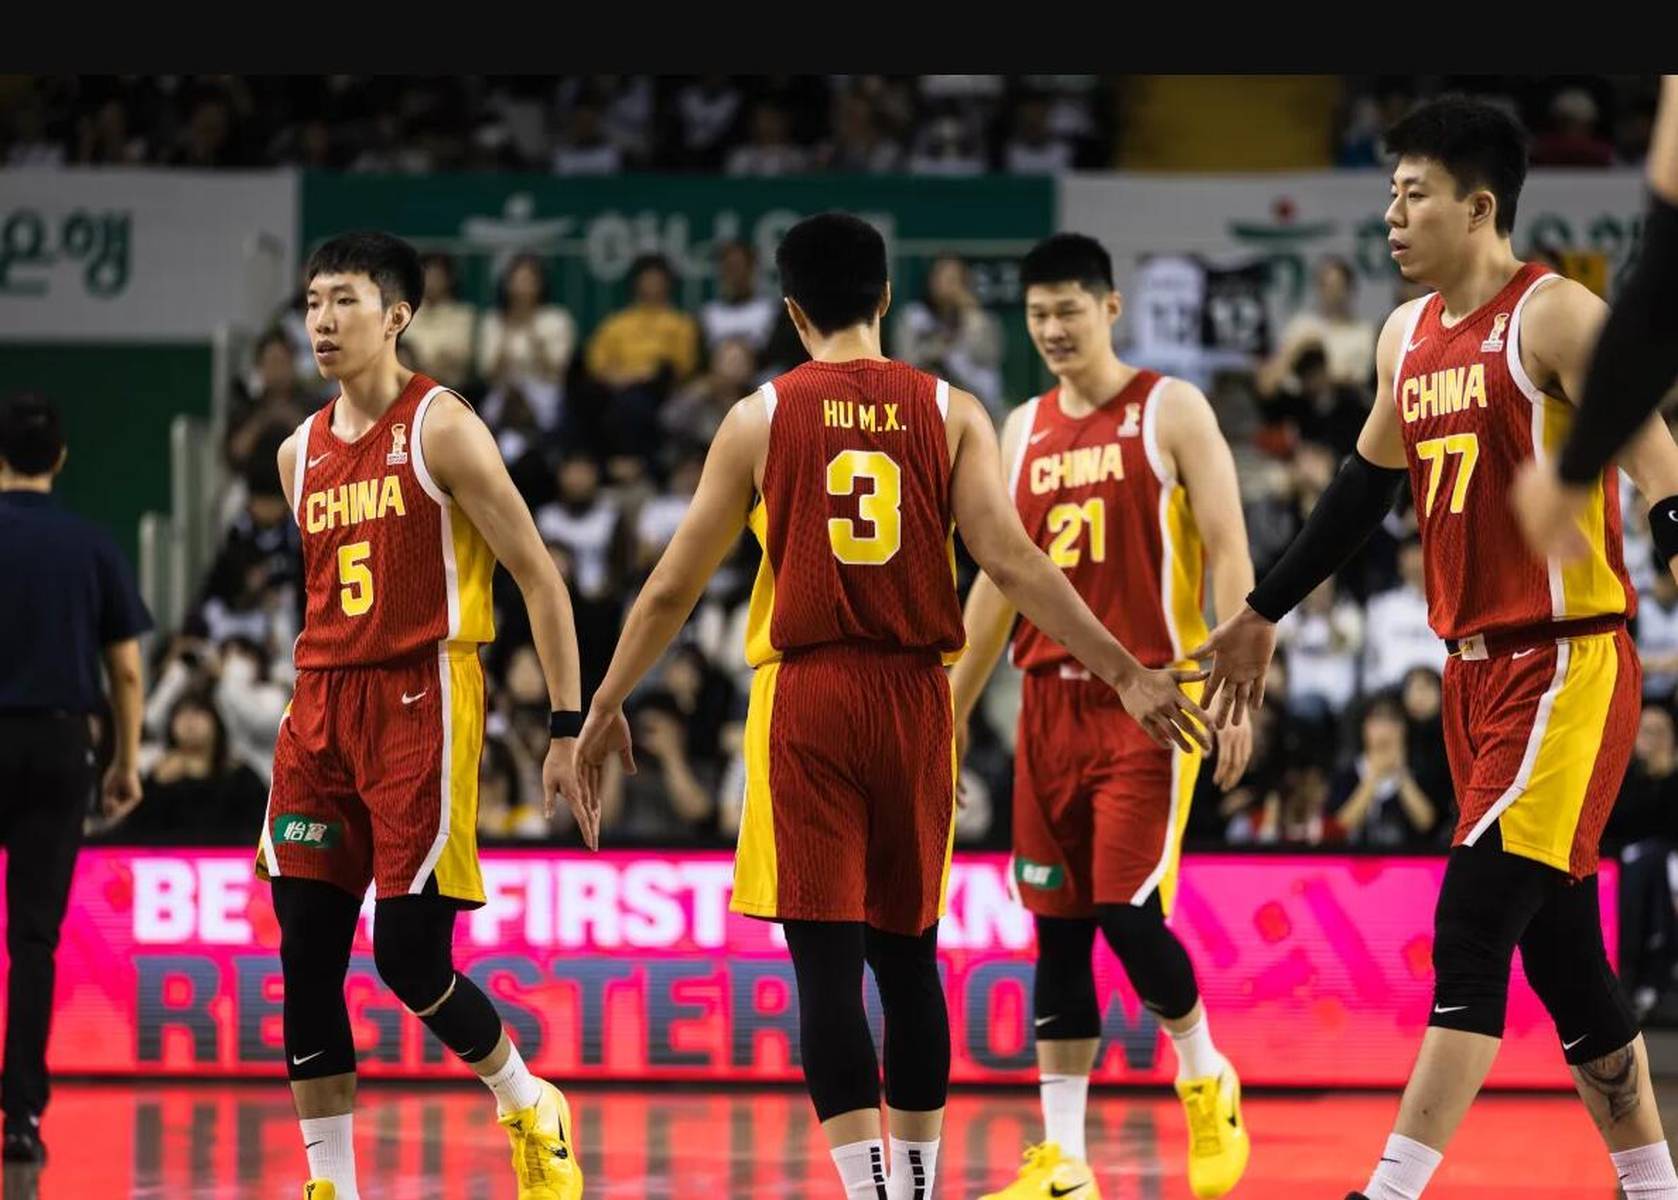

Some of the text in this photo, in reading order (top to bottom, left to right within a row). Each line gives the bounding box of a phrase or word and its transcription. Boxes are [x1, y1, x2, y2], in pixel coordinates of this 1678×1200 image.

[823, 399, 907, 432] HU M.X.
[1401, 363, 1488, 424] CHINA
[306, 474, 406, 535] CHINA
[1029, 442, 1125, 496] CHINA
[1416, 432, 1480, 518] 77
[826, 449, 901, 565] 3
[1047, 496, 1106, 568] 21
[337, 540, 374, 617] 5
[131, 859, 252, 944] BE
[468, 859, 737, 949] FIRST
[132, 953, 803, 1068] REGSTER
